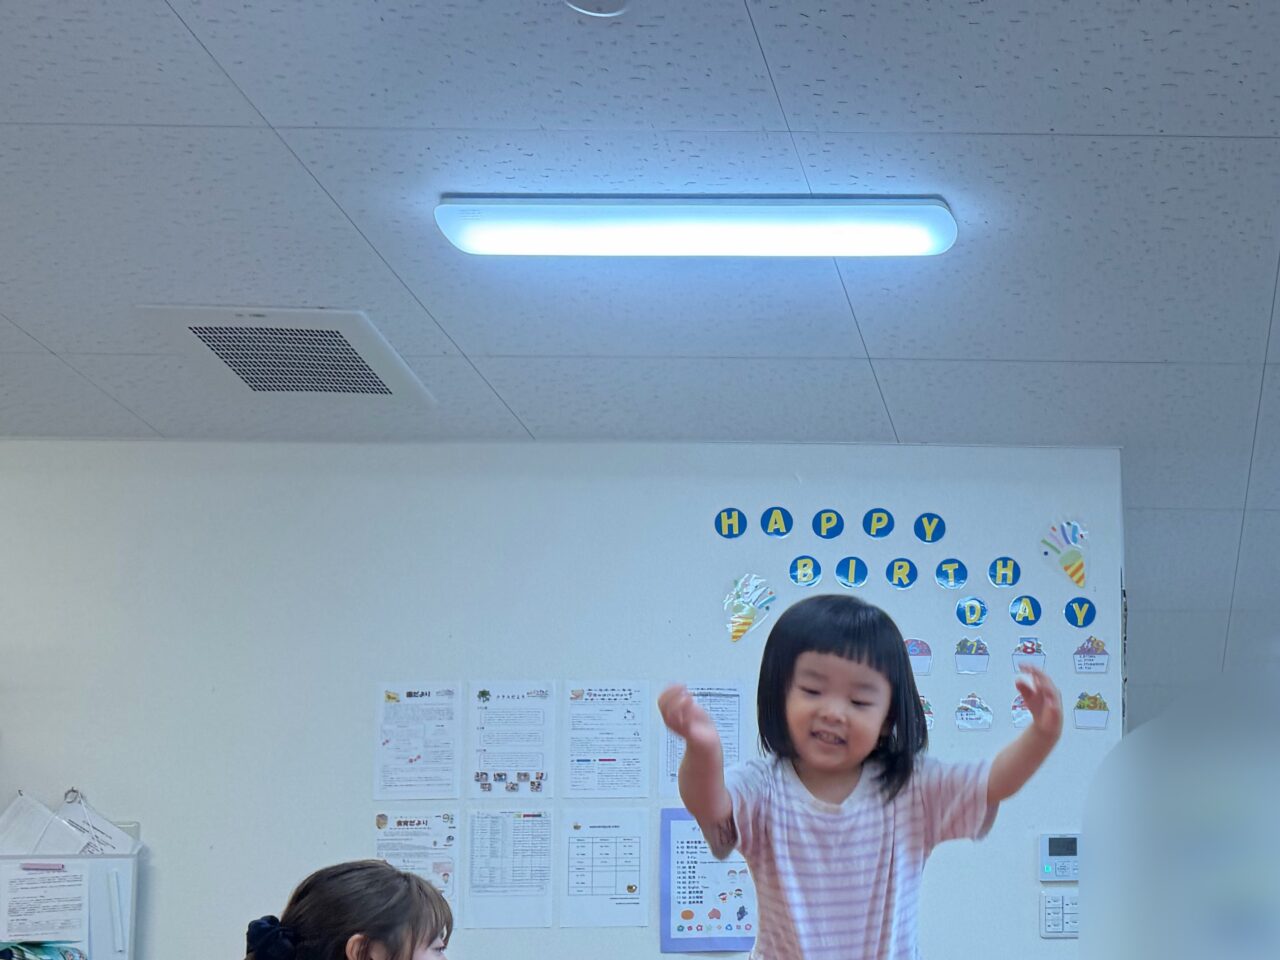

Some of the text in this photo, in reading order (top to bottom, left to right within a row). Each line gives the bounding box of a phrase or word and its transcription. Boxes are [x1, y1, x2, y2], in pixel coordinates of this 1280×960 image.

[721, 510, 938, 541] HAPPY
[797, 558, 1014, 586] BIRTH
[965, 598, 1091, 626] DAY
[1022, 640, 1036, 655] 8
